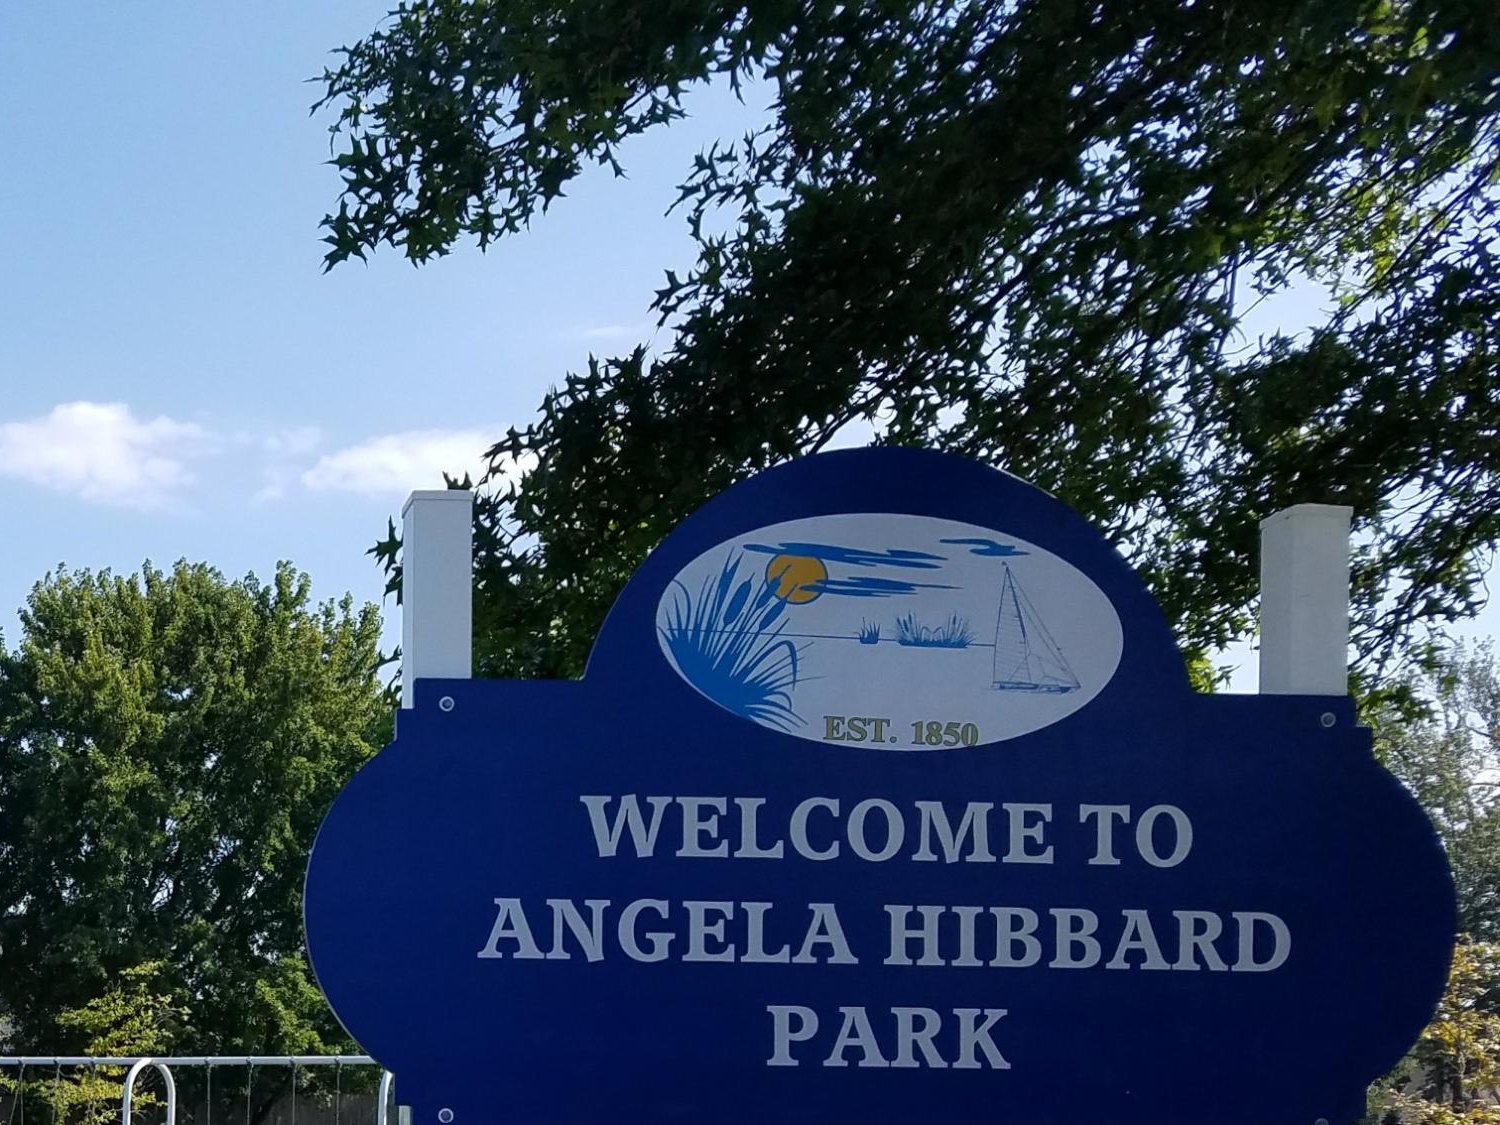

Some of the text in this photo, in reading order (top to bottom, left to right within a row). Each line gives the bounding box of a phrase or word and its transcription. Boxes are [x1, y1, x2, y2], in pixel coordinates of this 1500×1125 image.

[823, 716, 979, 747] EST. 1850
[580, 794, 1193, 867] WELCOME TO
[478, 897, 1292, 972] ANGELA HIBBARD
[767, 1005, 1012, 1070] PARK
